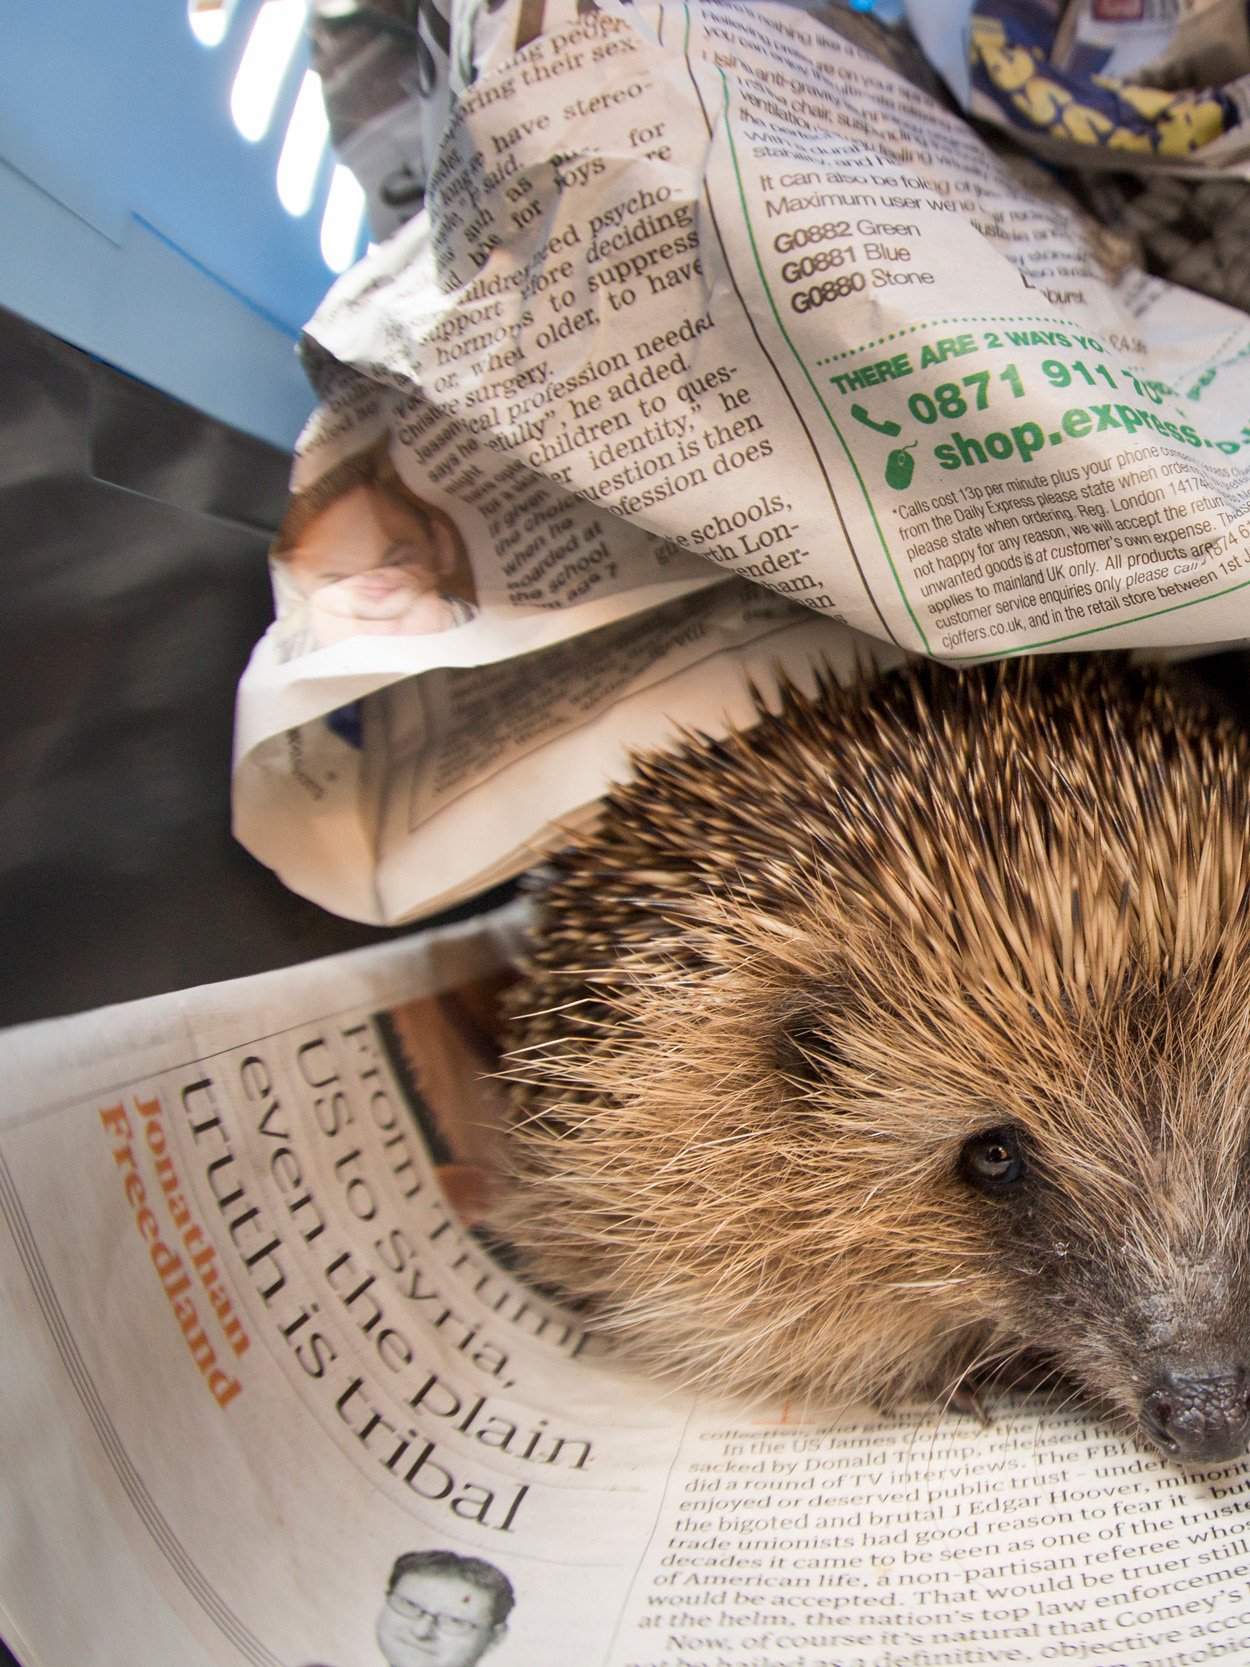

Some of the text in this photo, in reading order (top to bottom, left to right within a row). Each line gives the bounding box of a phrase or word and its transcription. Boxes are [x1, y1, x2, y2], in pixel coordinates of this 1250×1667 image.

[520, 36, 644, 87] their sex-
[491, 80, 653, 153] have stereo-
[628, 121, 666, 147] for
[759, 168, 897, 193] It can also be
[764, 190, 923, 219] Maximum user
[584, 205, 692, 264] deciding
[586, 184, 683, 236] psycho-
[773, 218, 922, 254] G0882 Green
[781, 242, 911, 284] G0881 Blue
[791, 266, 936, 315] G0880 Stone
[535, 258, 704, 350] older, to have
[549, 289, 575, 310] to
[507, 355, 630, 417] profession
[570, 355, 692, 419] he added.
[829, 329, 1105, 395] THERE ARE 2 WAYS YO
[528, 368, 738, 468] children to ques-
[722, 387, 752, 413] he
[907, 359, 1119, 425] 0871 911
[704, 412, 764, 450] then
[711, 438, 773, 477] does
[932, 491, 958, 510] cost
[960, 485, 983, 504] 13p
[985, 482, 1005, 499] per
[1006, 471, 1049, 494] minute
[1051, 466, 1080, 488] plus
[1082, 458, 1112, 480] your
[1116, 445, 1159, 469] phone
[692, 494, 792, 546] schools,
[739, 524, 799, 554] Lon-
[927, 546, 1188, 616] applies to mainland UK only. All products
[1028, 611, 1050, 630] and
[1050, 609, 1063, 624] in
[1064, 604, 1086, 621] the
[1087, 598, 1121, 616] retail
[1121, 586, 1157, 609] store
[1157, 568, 1218, 600] between
[1219, 557, 1243, 576] 1st
[135, 1094, 250, 1358] Jonathan
[297, 1038, 518, 1390] US to Syria,
[100, 1102, 243, 1412] Freedland
[239, 1055, 595, 1472] even the plain
[181, 1077, 532, 1535] truth is tribal
[805, 1443, 976, 1472] Donald Trump,
[674, 1518, 711, 1532] the
[718, 1512, 809, 1535] bigoted
[815, 1511, 861, 1528] and
[869, 1503, 944, 1526] brutal
[969, 1494, 1042, 1520] Edgar
[1049, 1479, 1150, 1505] Hoover,
